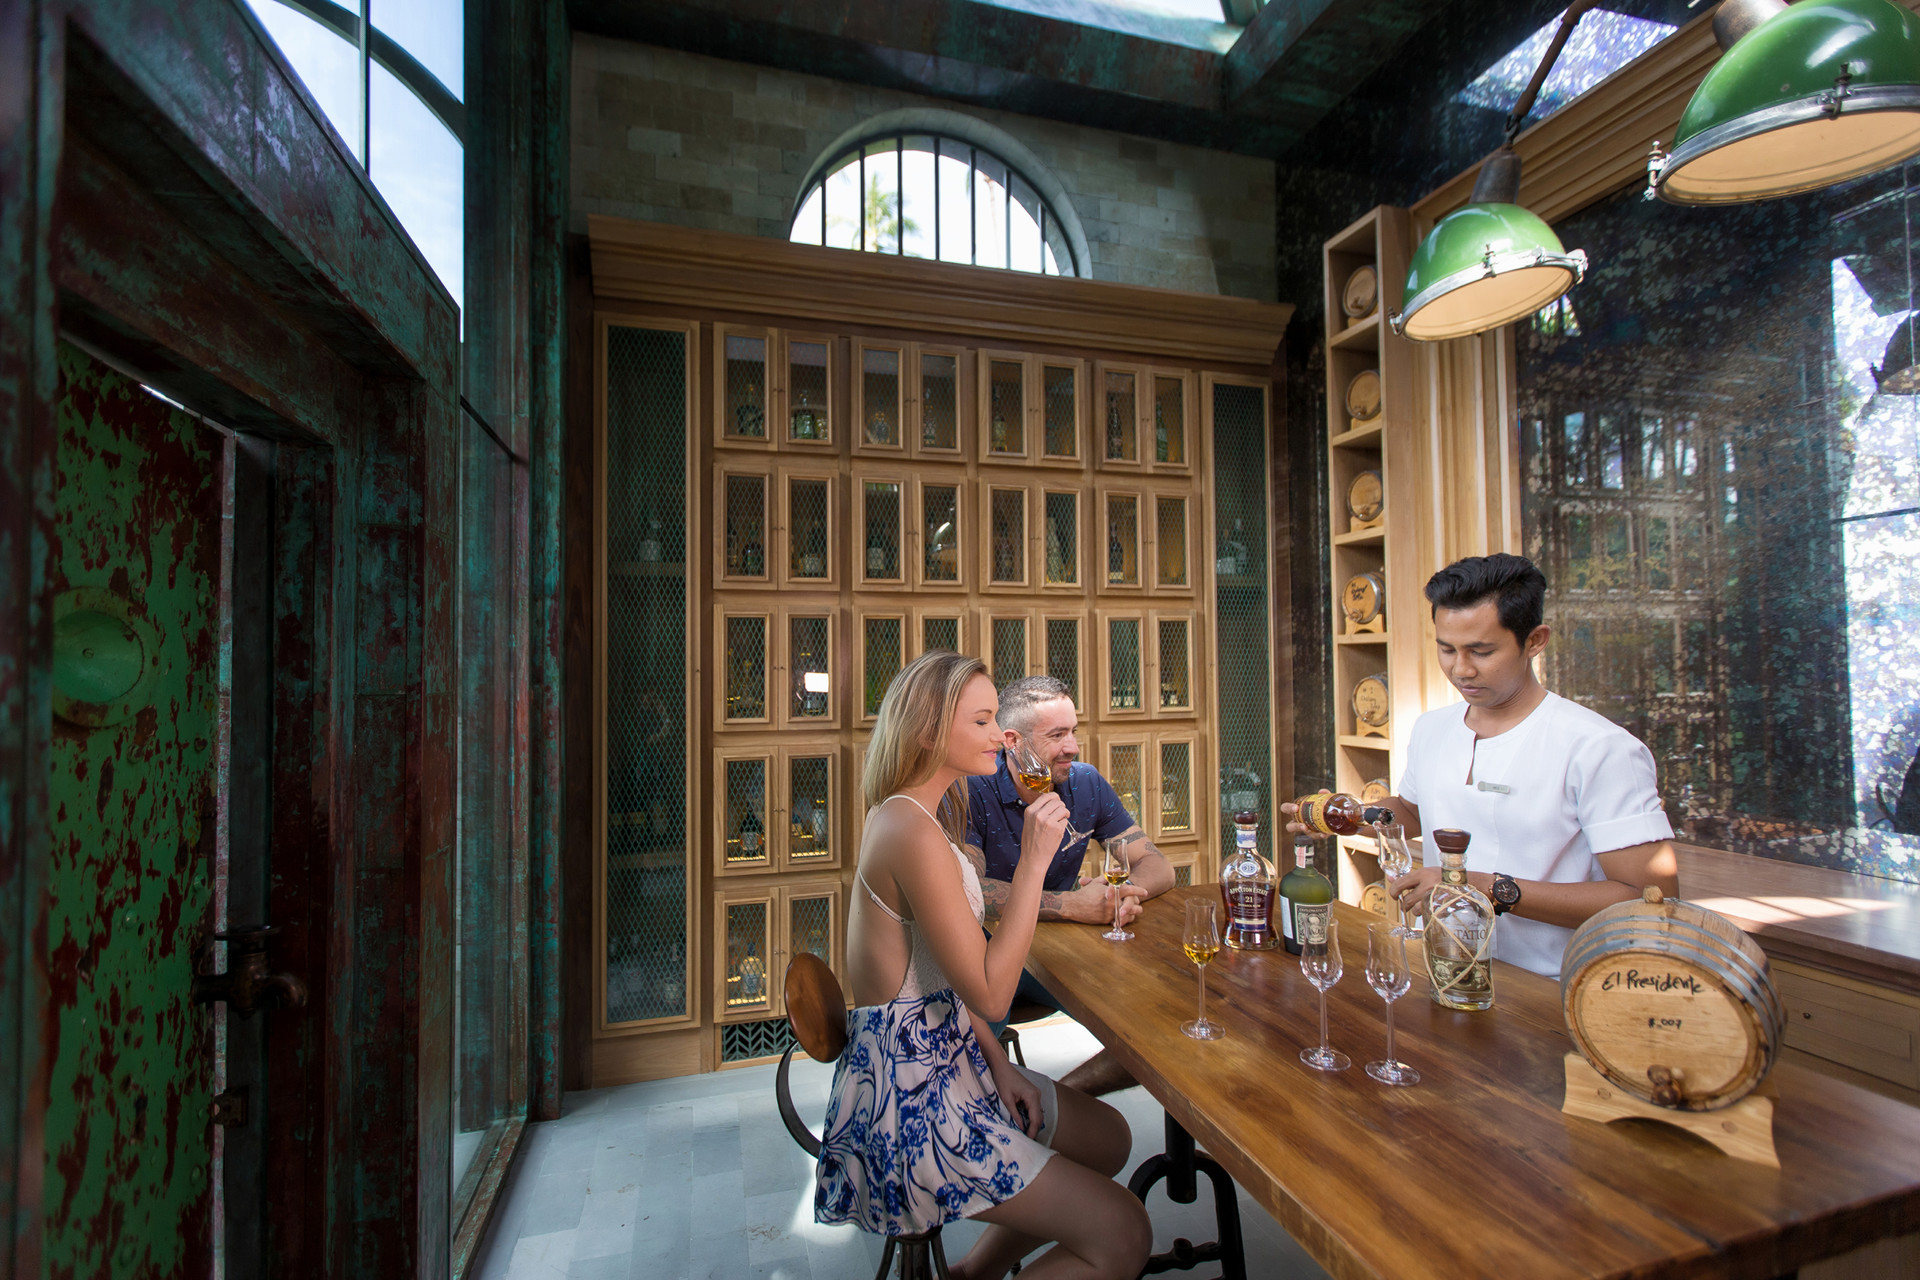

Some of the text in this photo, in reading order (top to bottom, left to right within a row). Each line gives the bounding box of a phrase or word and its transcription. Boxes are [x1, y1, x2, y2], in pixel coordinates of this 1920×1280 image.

[1253, 887, 1268, 896] ESTATE
[1602, 969, 1705, 995] El Presidente
